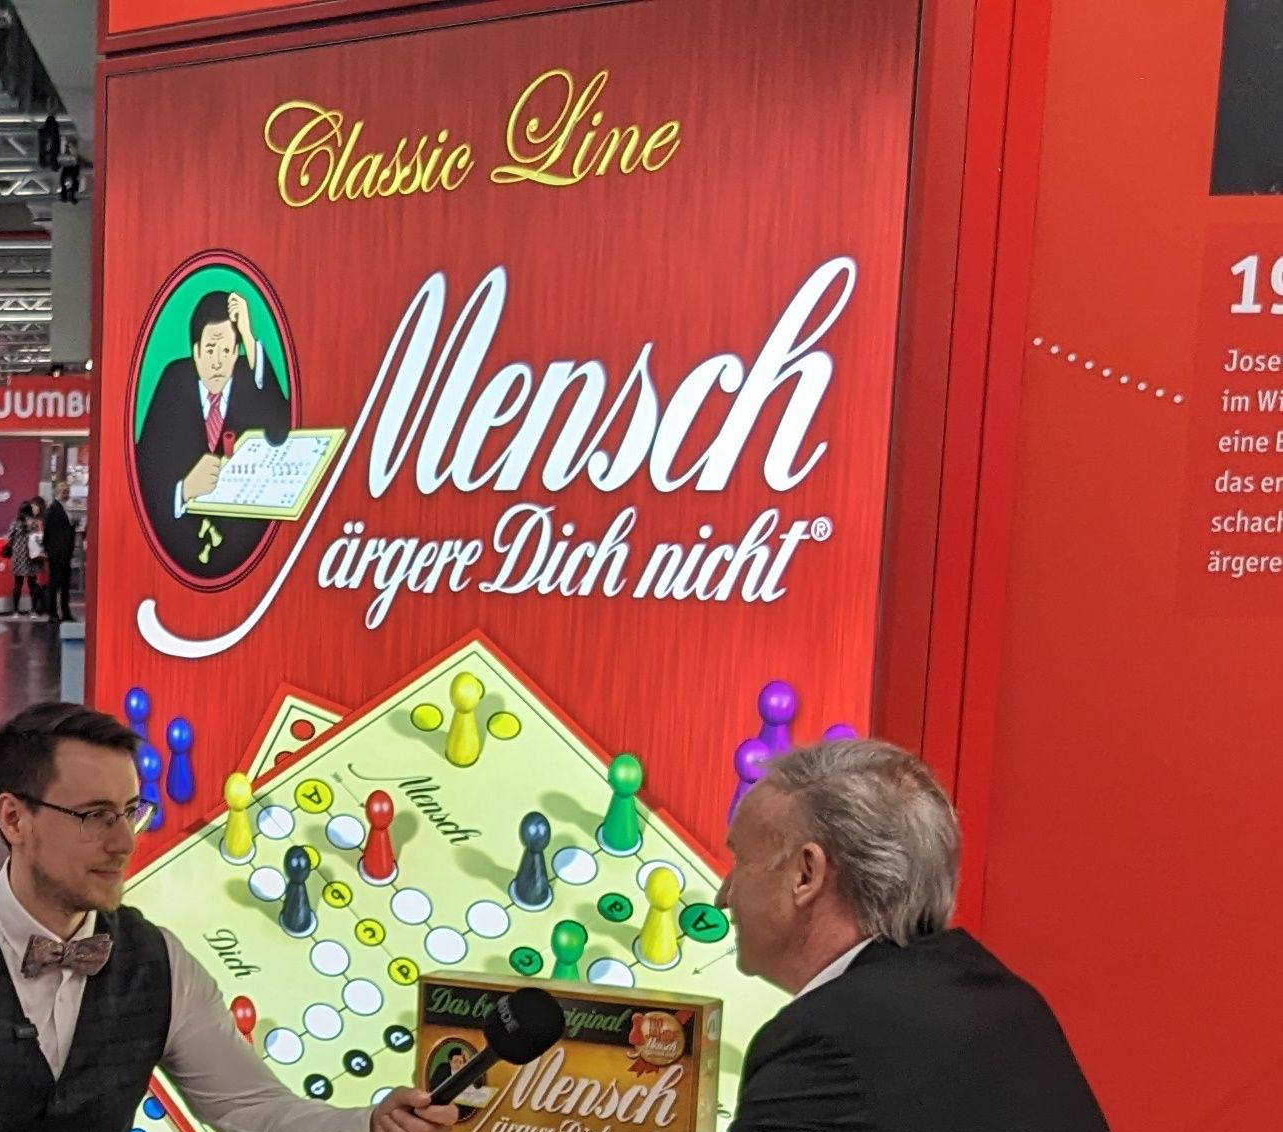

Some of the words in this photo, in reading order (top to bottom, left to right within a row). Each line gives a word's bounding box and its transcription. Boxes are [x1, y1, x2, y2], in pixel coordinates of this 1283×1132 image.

[264, 100, 475, 208] Classic
[491, 69, 681, 187] Line
[1224, 349, 1283, 372] Jose
[1222, 389, 1250, 412] im
[1218, 430, 1269, 453] eine
[1214, 470, 1255, 494] das
[318, 522, 485, 630] ärgere
[482, 503, 637, 597] Dich
[1207, 550, 1283, 579] ärgere
[202, 928, 263, 980] Dich
[425, 987, 471, 1016] Das
[564, 1008, 633, 1039] riginal
